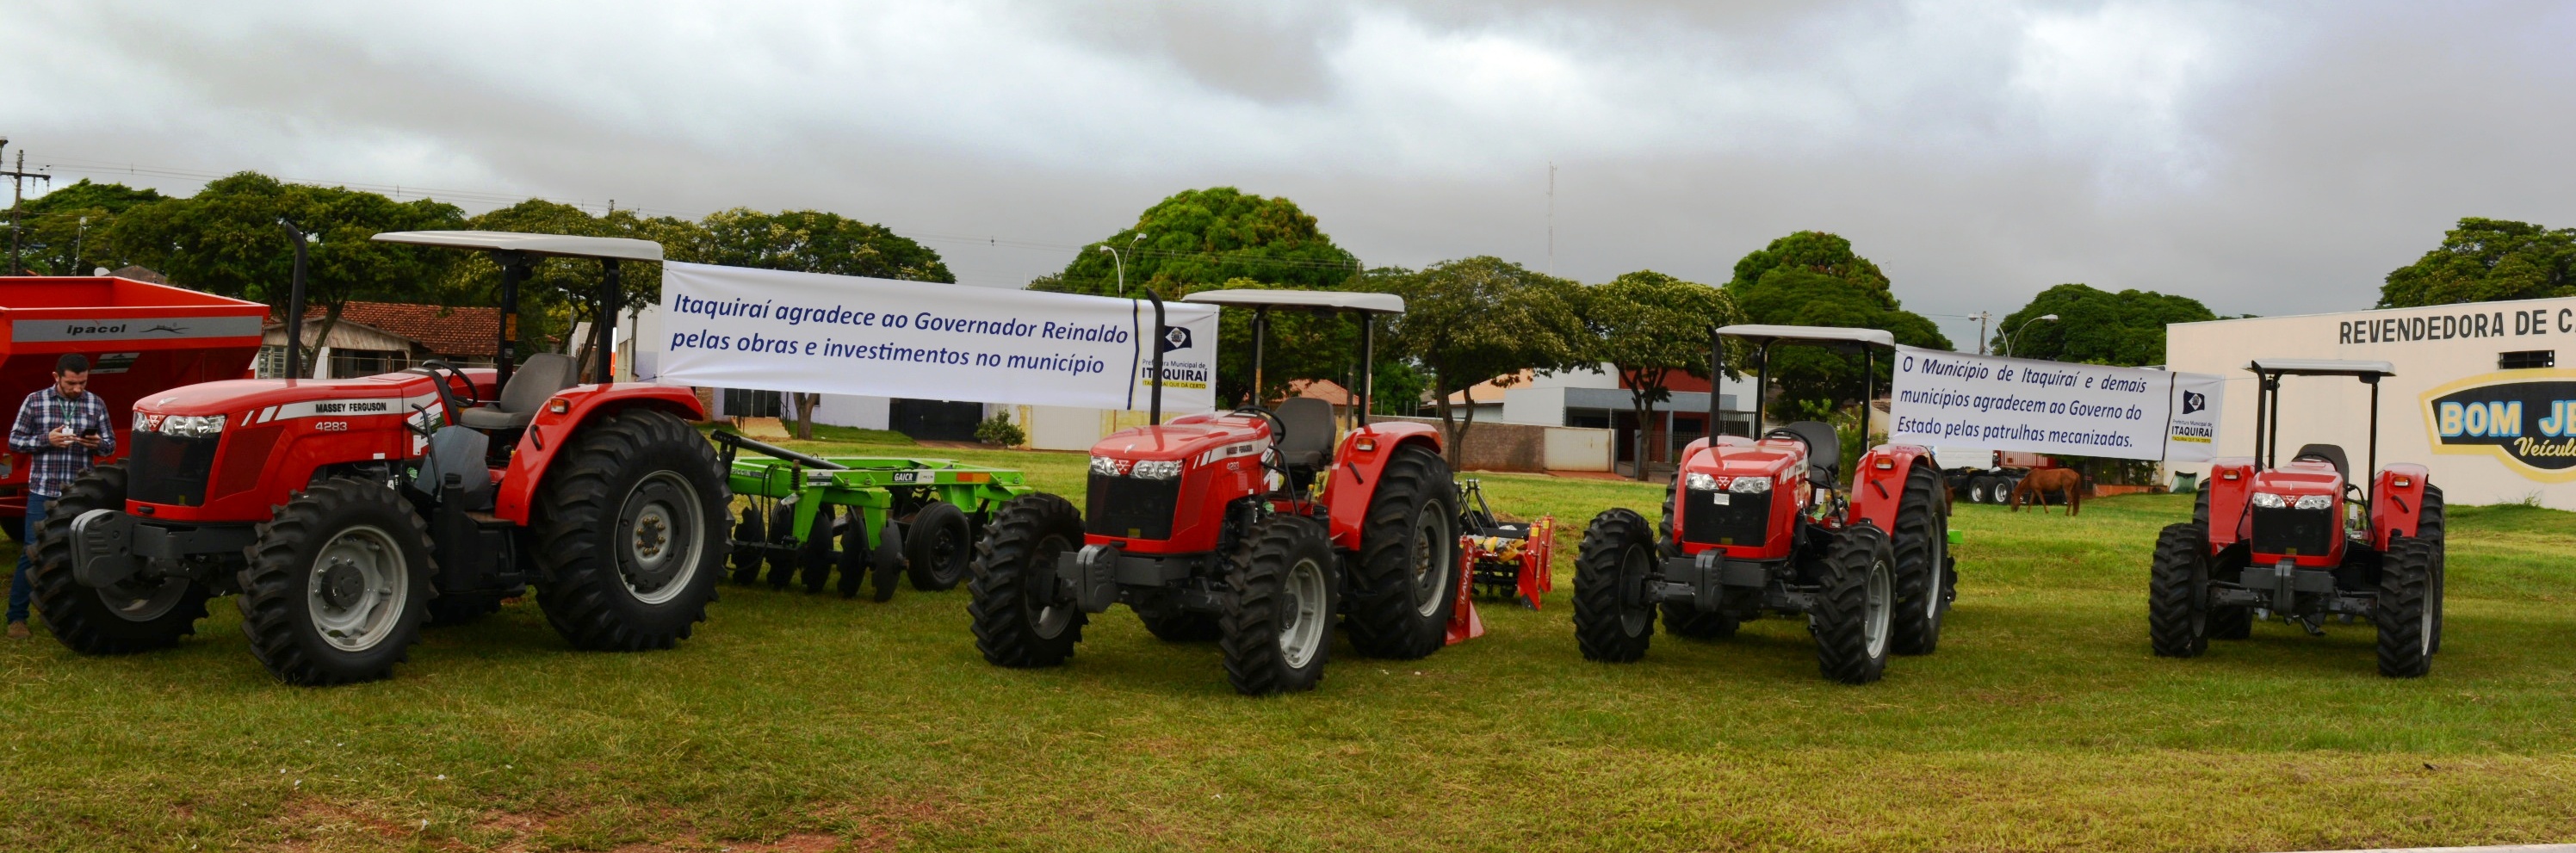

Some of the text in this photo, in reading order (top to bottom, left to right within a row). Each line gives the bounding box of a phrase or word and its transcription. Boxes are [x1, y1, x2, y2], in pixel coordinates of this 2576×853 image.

[673, 294, 1128, 343] Itaquiraí agradece ao Governador Reinaldo
[2339, 308, 2576, 344] REVENDEDORA DE C
[671, 329, 1104, 376] pelas obras e investimentos no município
[1170, 361, 1197, 369] Municipal
[1142, 367, 1208, 382] ITQUIRAÍ
[1903, 355, 2147, 393] O Município de Itaquiraí e demais
[316, 402, 387, 413] MASSEY FERGUSON
[1900, 388, 2142, 420] municípios agradecem ao Governo do
[2440, 400, 2576, 437] BOM JE
[315, 421, 347, 431] 4283
[1898, 416, 2133, 448] Estado pelas patrulhas mecanizadas.
[2172, 425, 2213, 438] ITAQUIRAÍ
[894, 473, 913, 481] GAICR
[1461, 547, 1473, 601] LAVRALE
